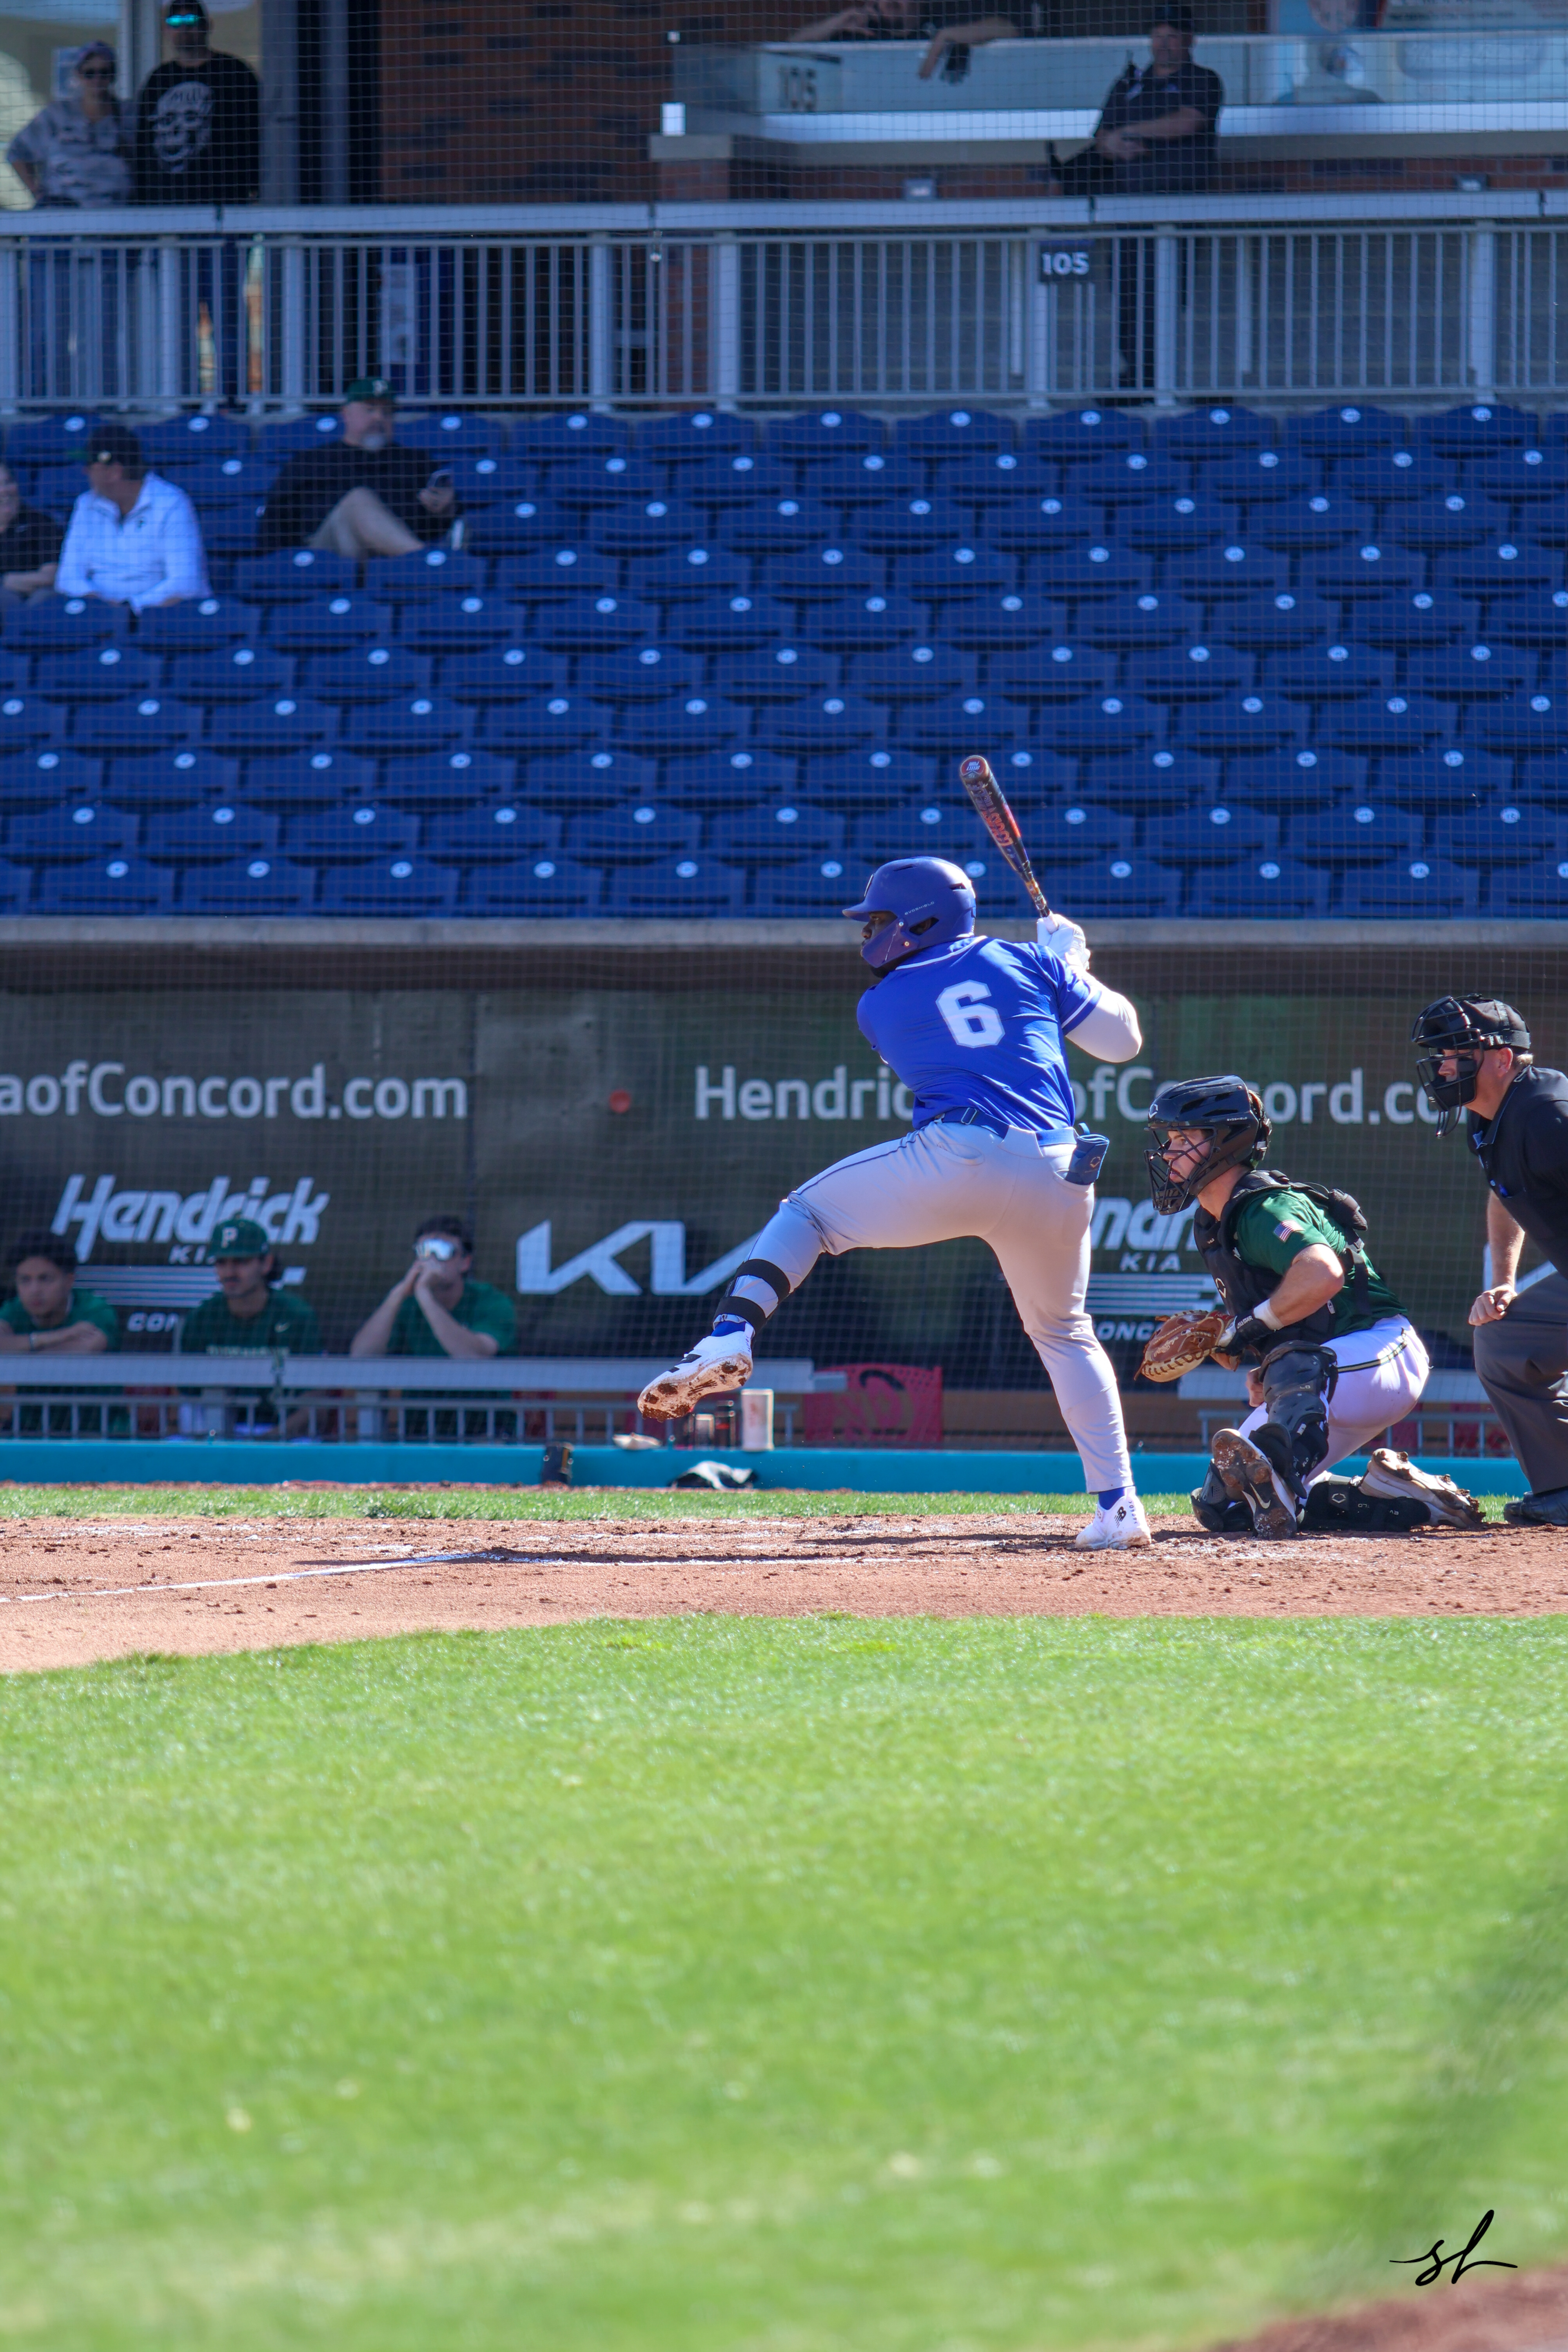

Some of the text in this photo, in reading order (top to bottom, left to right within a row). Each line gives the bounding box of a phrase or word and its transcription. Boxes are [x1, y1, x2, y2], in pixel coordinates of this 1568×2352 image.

[1042, 252, 1089, 275] 105
[904, 901, 934, 915] EVOSHIELD
[935, 979, 1005, 1048] 6
[0, 1060, 467, 1119] aofConcord.com
[49, 1174, 330, 1263] Hendrick
[221, 1227, 238, 1248] P
[168, 1245, 216, 1264] KI
[1119, 1252, 1181, 1272] KIA
